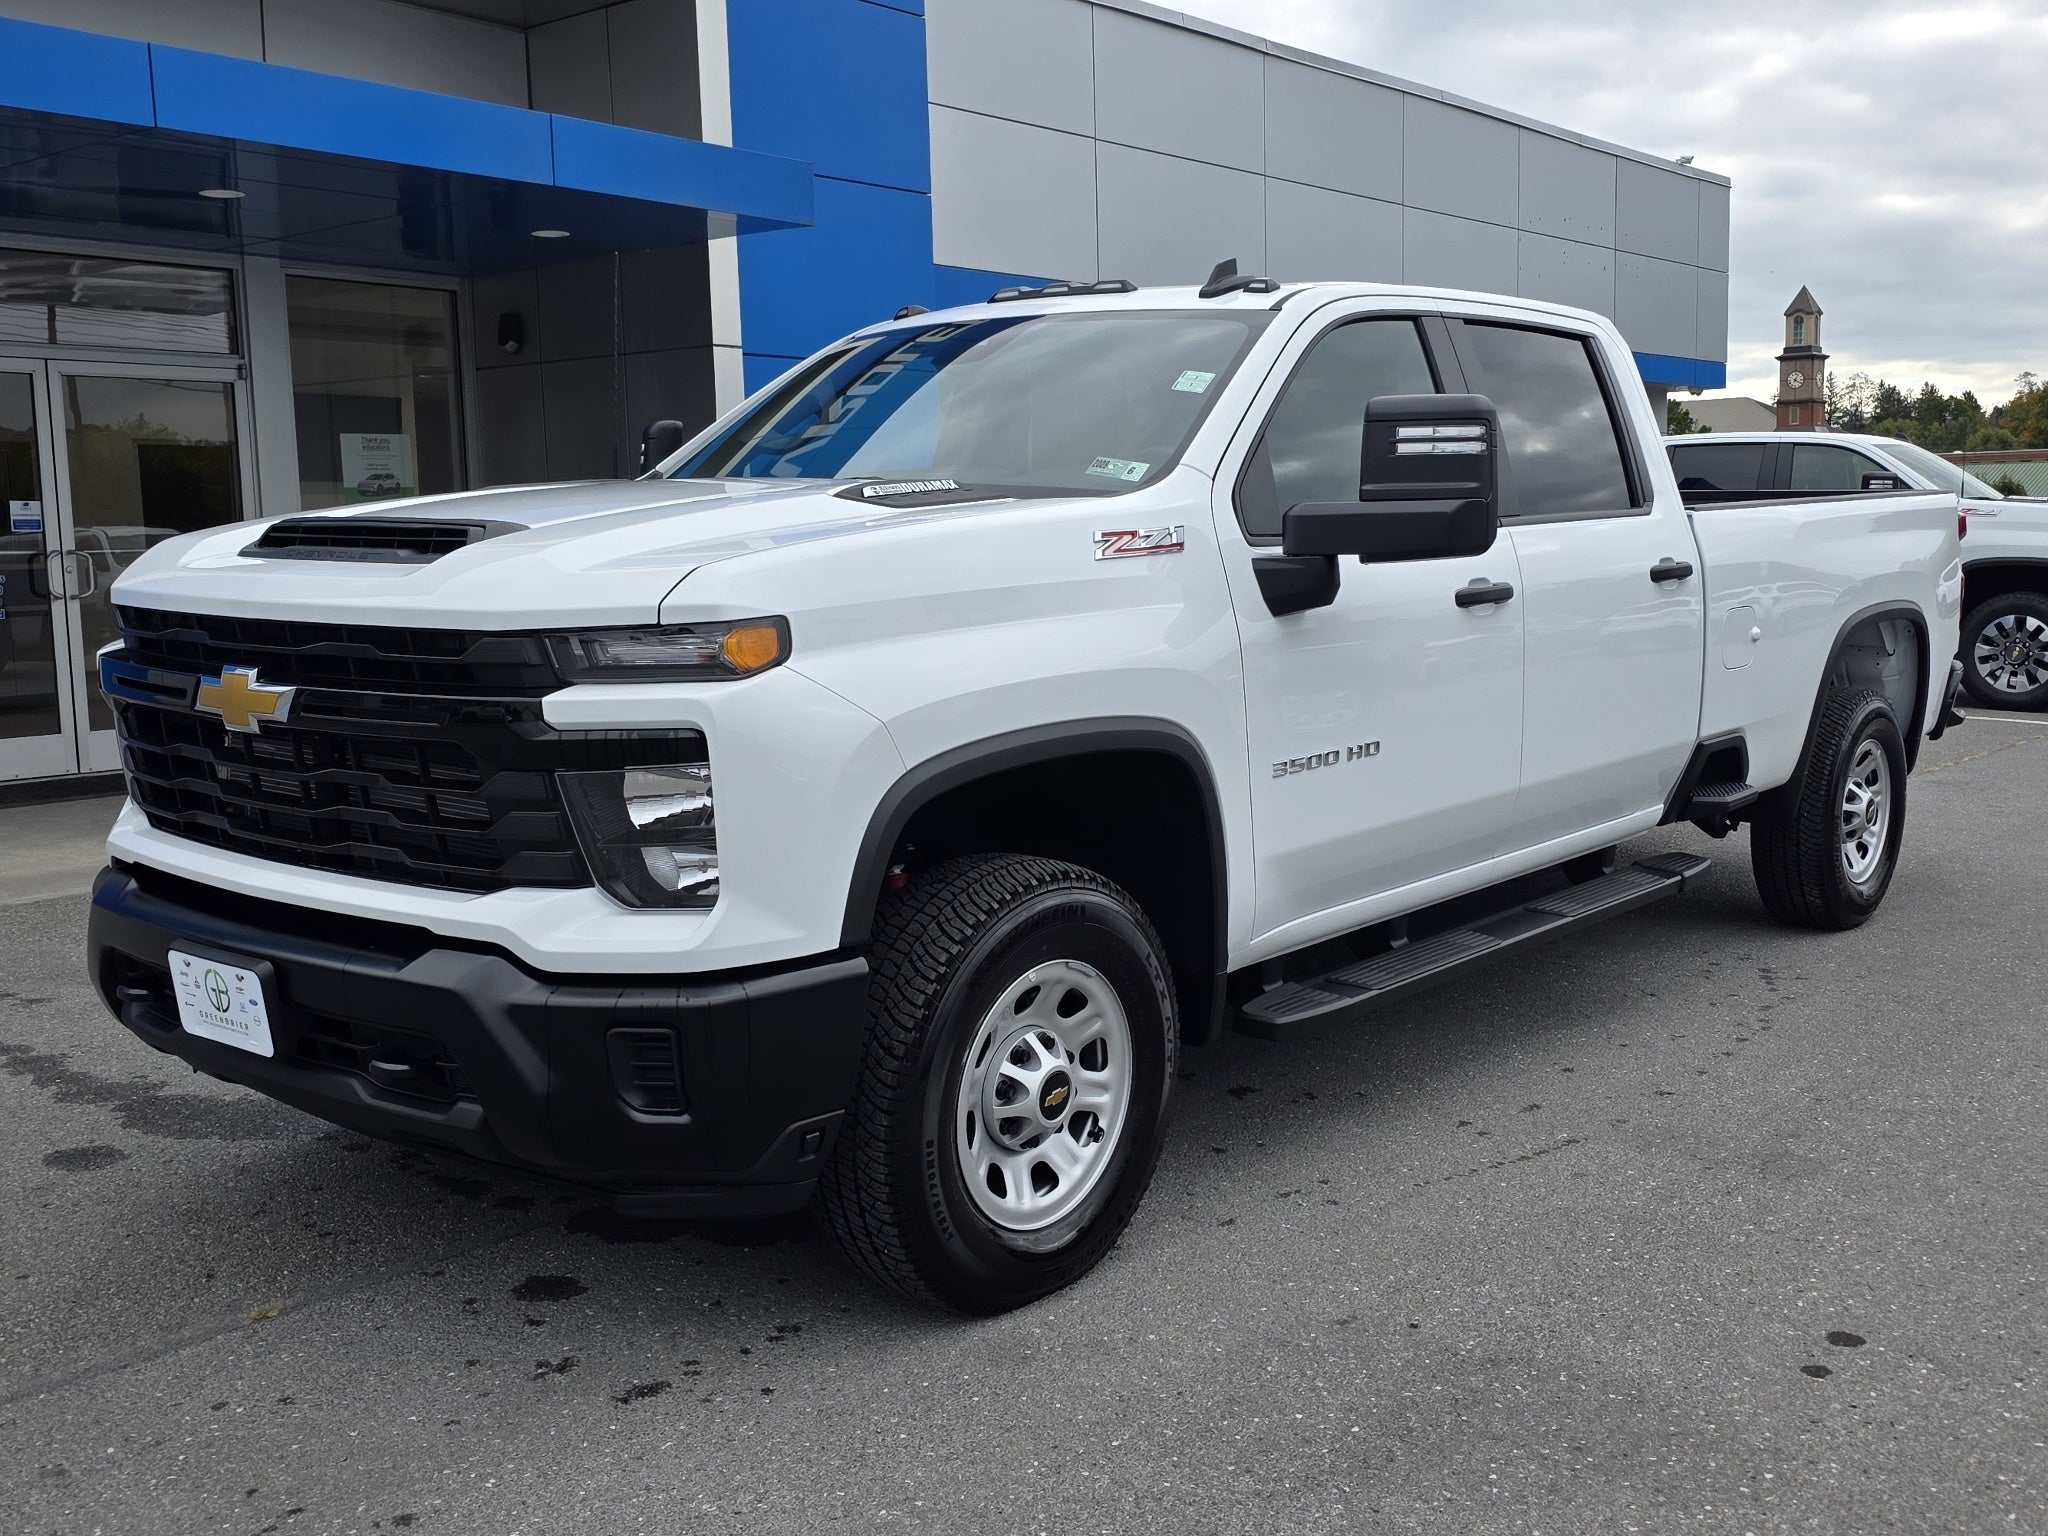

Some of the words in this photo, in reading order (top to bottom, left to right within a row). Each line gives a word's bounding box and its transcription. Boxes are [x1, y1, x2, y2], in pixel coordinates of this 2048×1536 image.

[1126, 466, 1136, 475] 6
[902, 479, 960, 493] DURAMAX
[1093, 525, 1184, 561] Z71
[286, 549, 383, 560] CHEVROLET
[1272, 748, 1339, 778] 3500
[1346, 740, 1380, 762] HD
[199, 1010, 250, 1031] GREENBRIER
